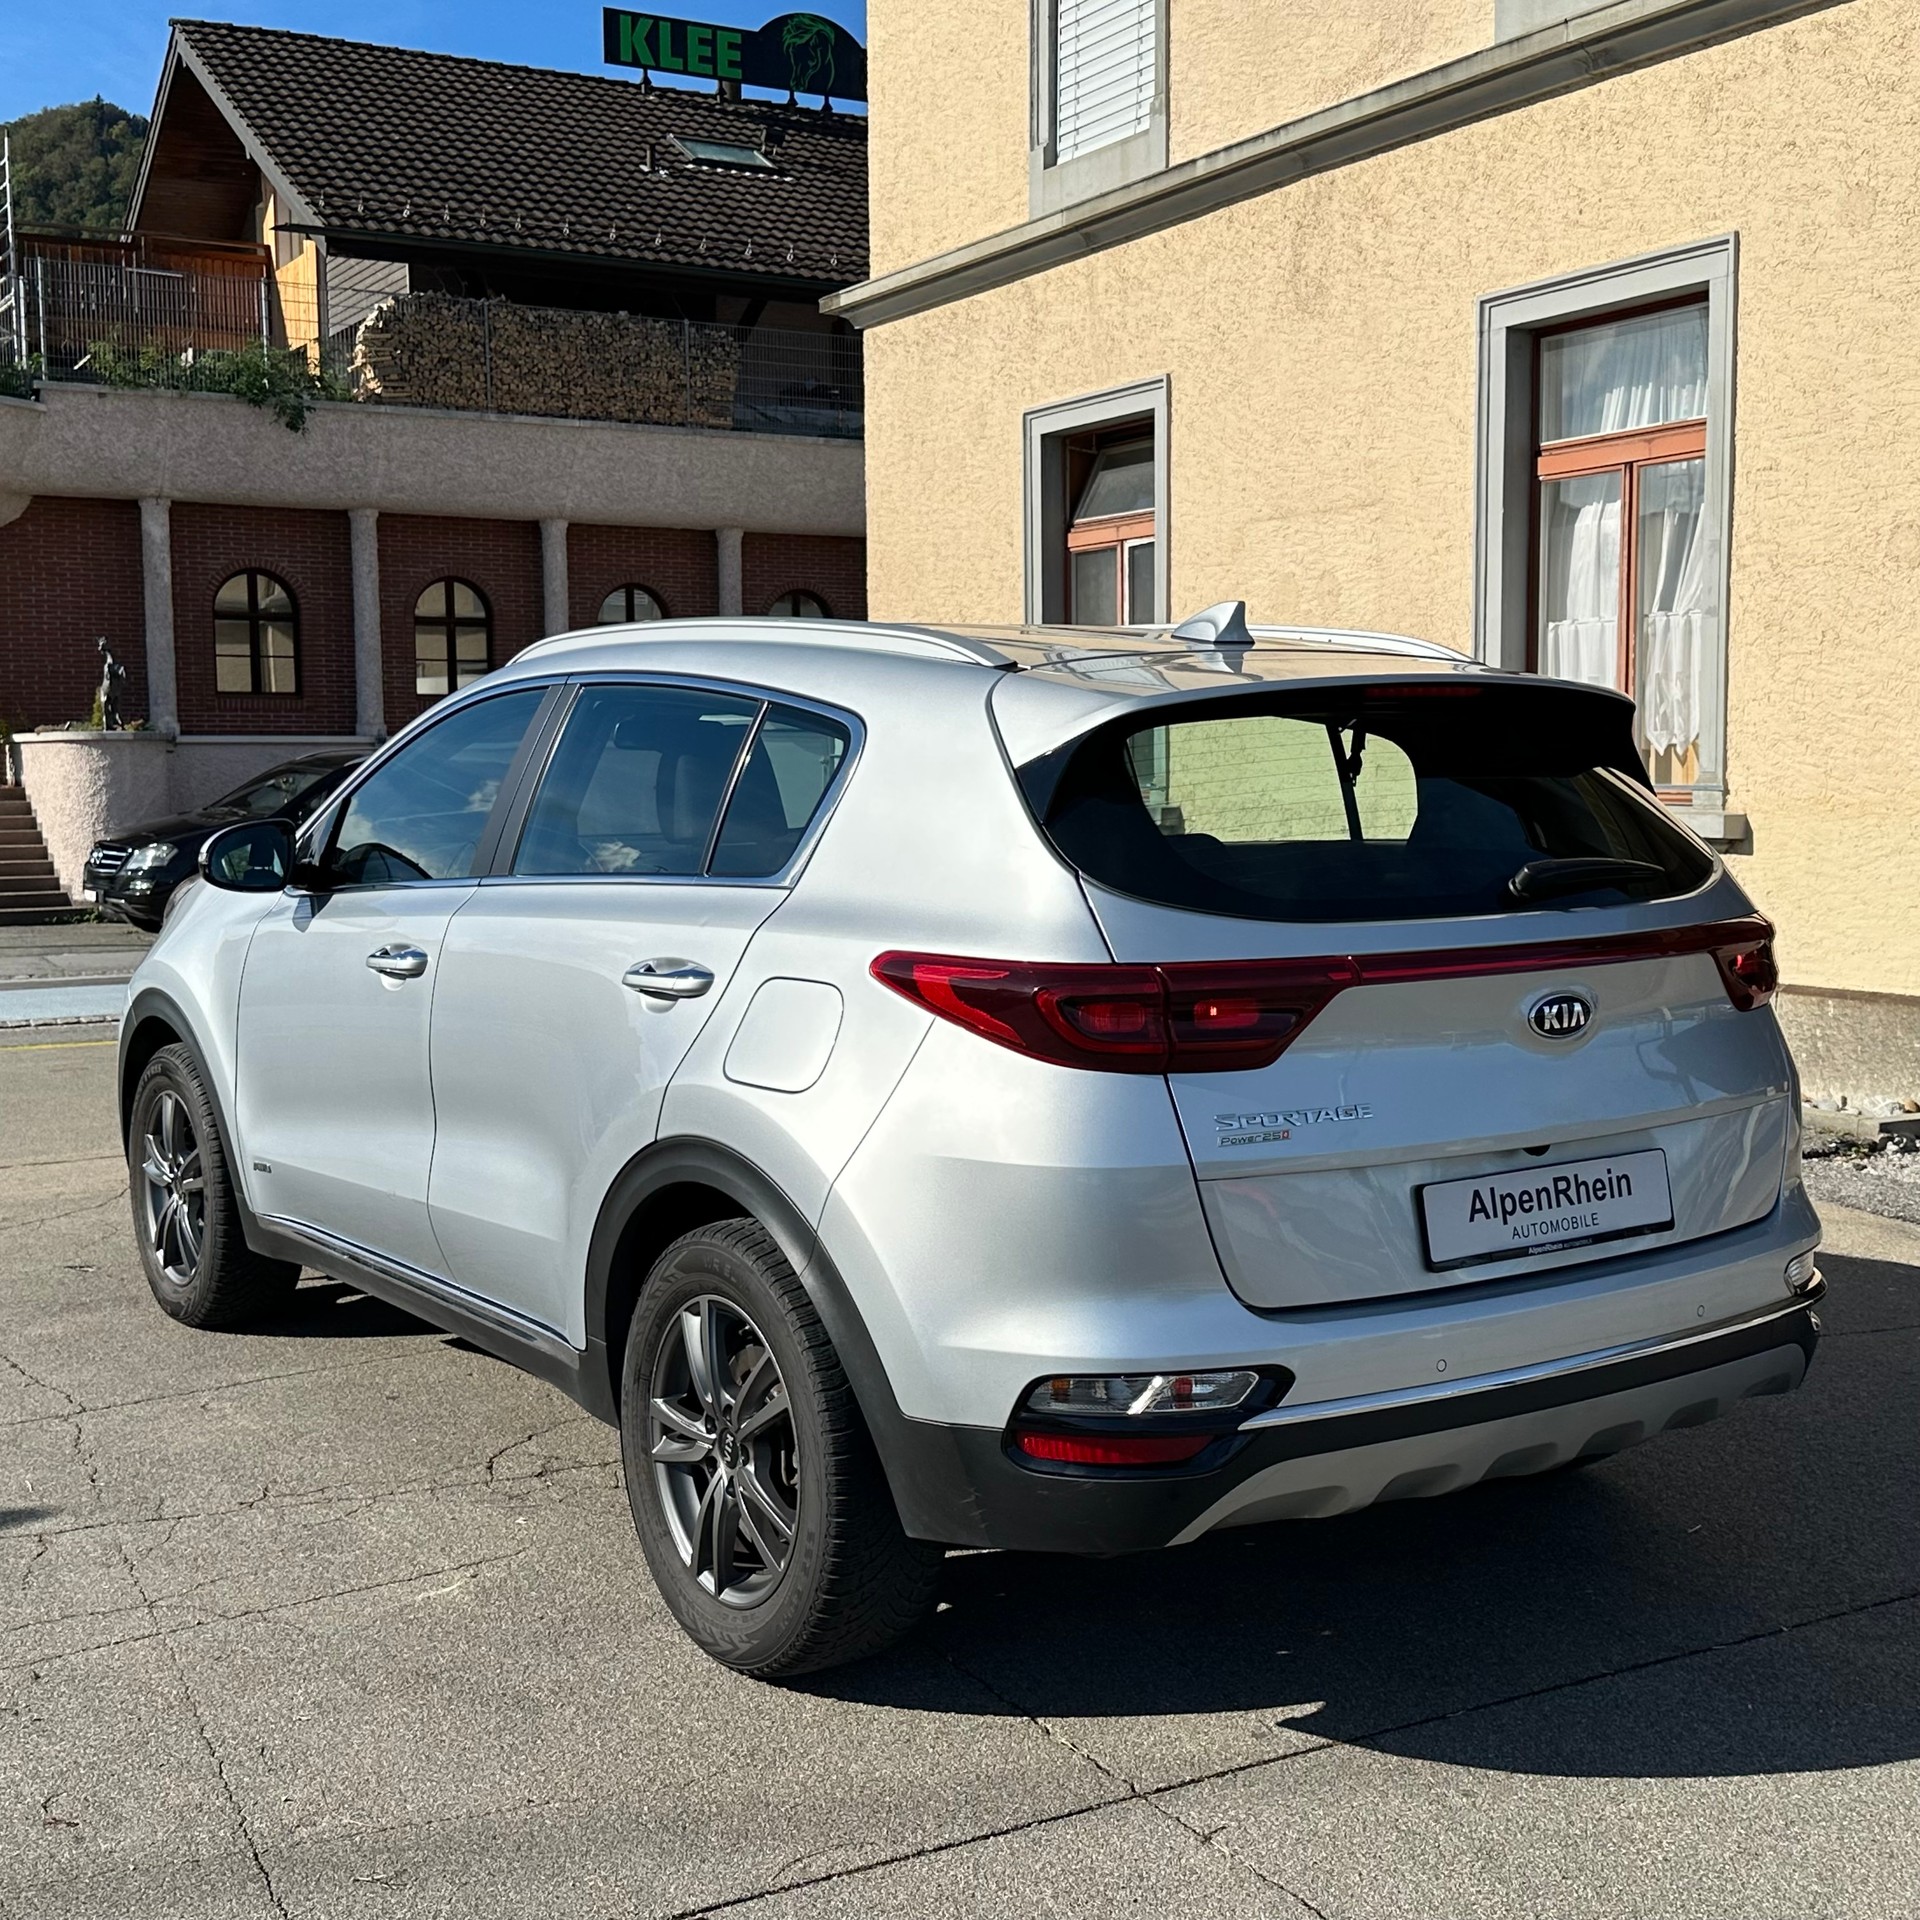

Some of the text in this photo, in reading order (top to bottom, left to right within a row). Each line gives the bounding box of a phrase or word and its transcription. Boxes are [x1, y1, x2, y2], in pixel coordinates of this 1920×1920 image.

[620, 14, 742, 79] KLEE
[1542, 1002, 1585, 1030] KIA
[1213, 1103, 1374, 1131] SPORTAGE
[1468, 1168, 1633, 1225] AlpenRhein
[1511, 1212, 1600, 1240] AUTOMOBILE
